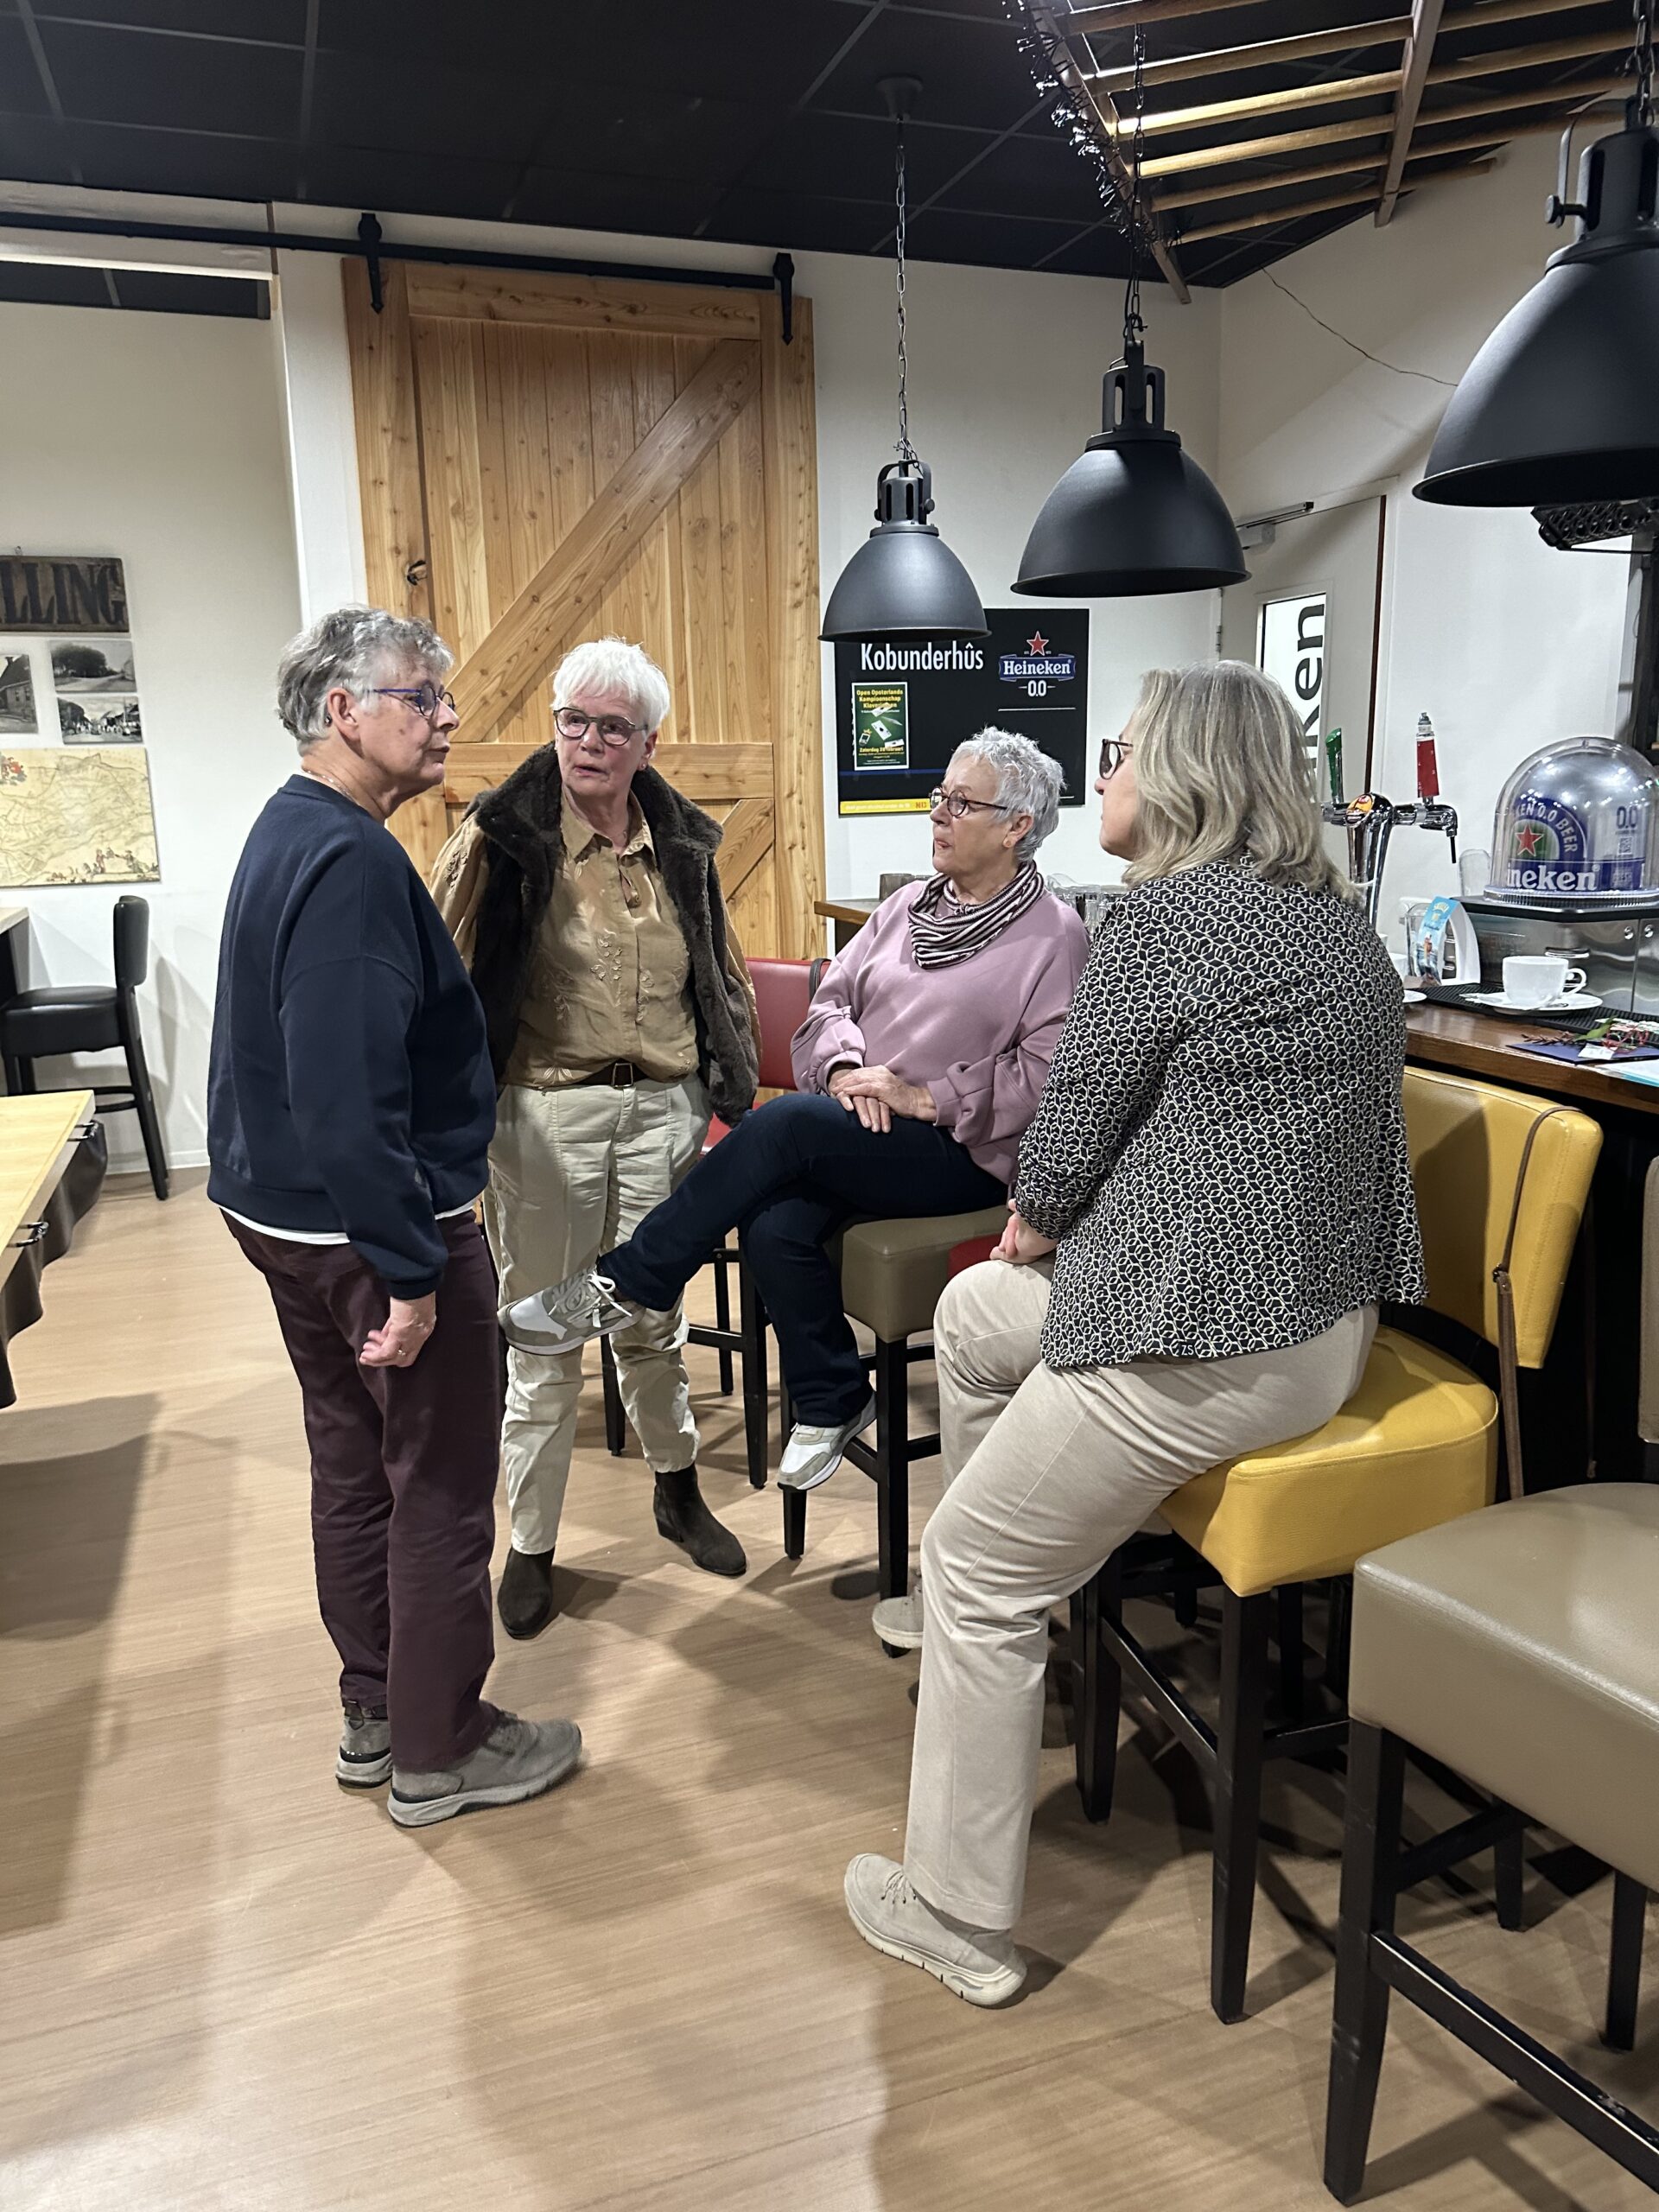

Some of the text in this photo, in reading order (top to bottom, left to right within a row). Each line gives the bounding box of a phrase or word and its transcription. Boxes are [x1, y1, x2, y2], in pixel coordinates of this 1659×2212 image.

[0, 562, 127, 625] LLING
[861, 640, 983, 671] Kobunderhûs
[1003, 660, 1071, 675] Heineken
[1027, 680, 1046, 696] 0.0
[1295, 604, 1325, 767] ken
[1555, 818, 1578, 852] BEER
